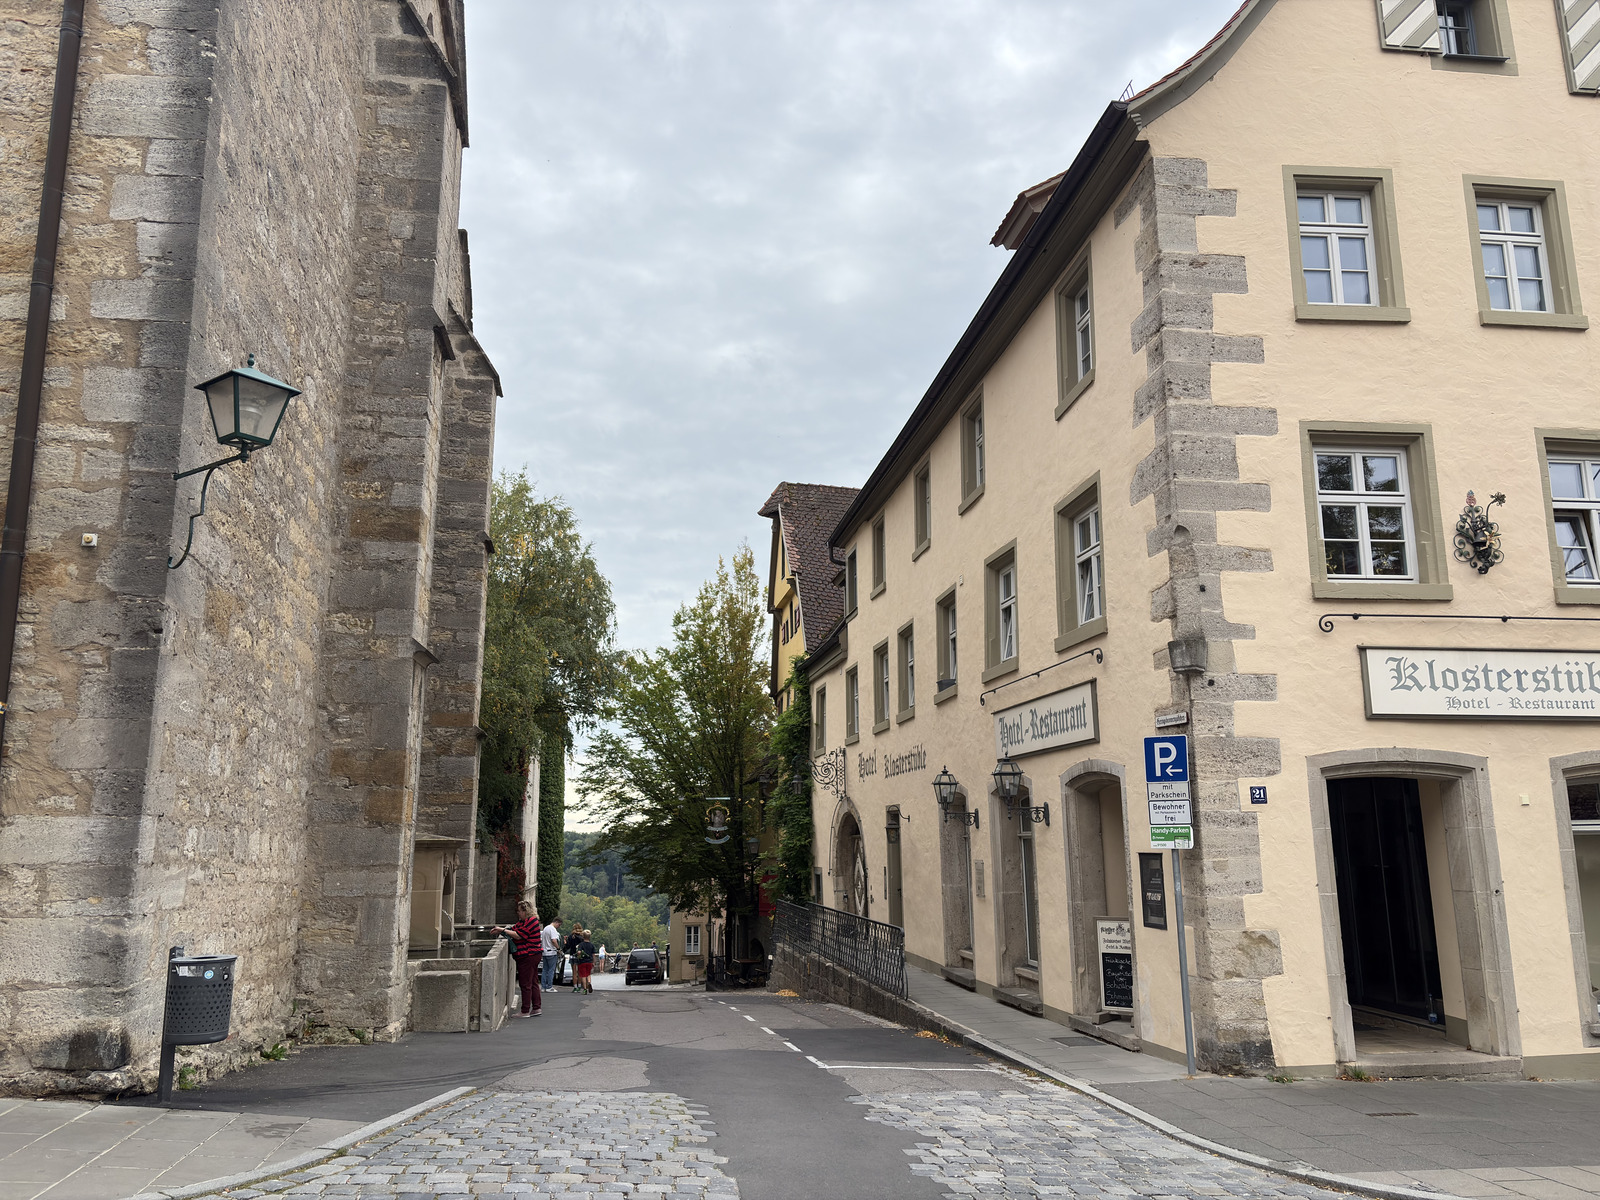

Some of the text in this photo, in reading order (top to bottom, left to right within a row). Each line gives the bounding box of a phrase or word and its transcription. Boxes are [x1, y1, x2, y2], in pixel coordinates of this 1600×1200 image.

[1385, 656, 1600, 694] Klosterstüb
[1445, 696, 1491, 711] Hotel
[1508, 696, 1596, 710] Restaurant
[858, 742, 927, 783] Hotel Klosterstüble
[1153, 742, 1177, 777] P
[1150, 791, 1187, 799] Parkschein
[1252, 789, 1265, 799] 21
[1152, 803, 1186, 811] Bewohner
[1151, 827, 1190, 835] Handy-Parken
